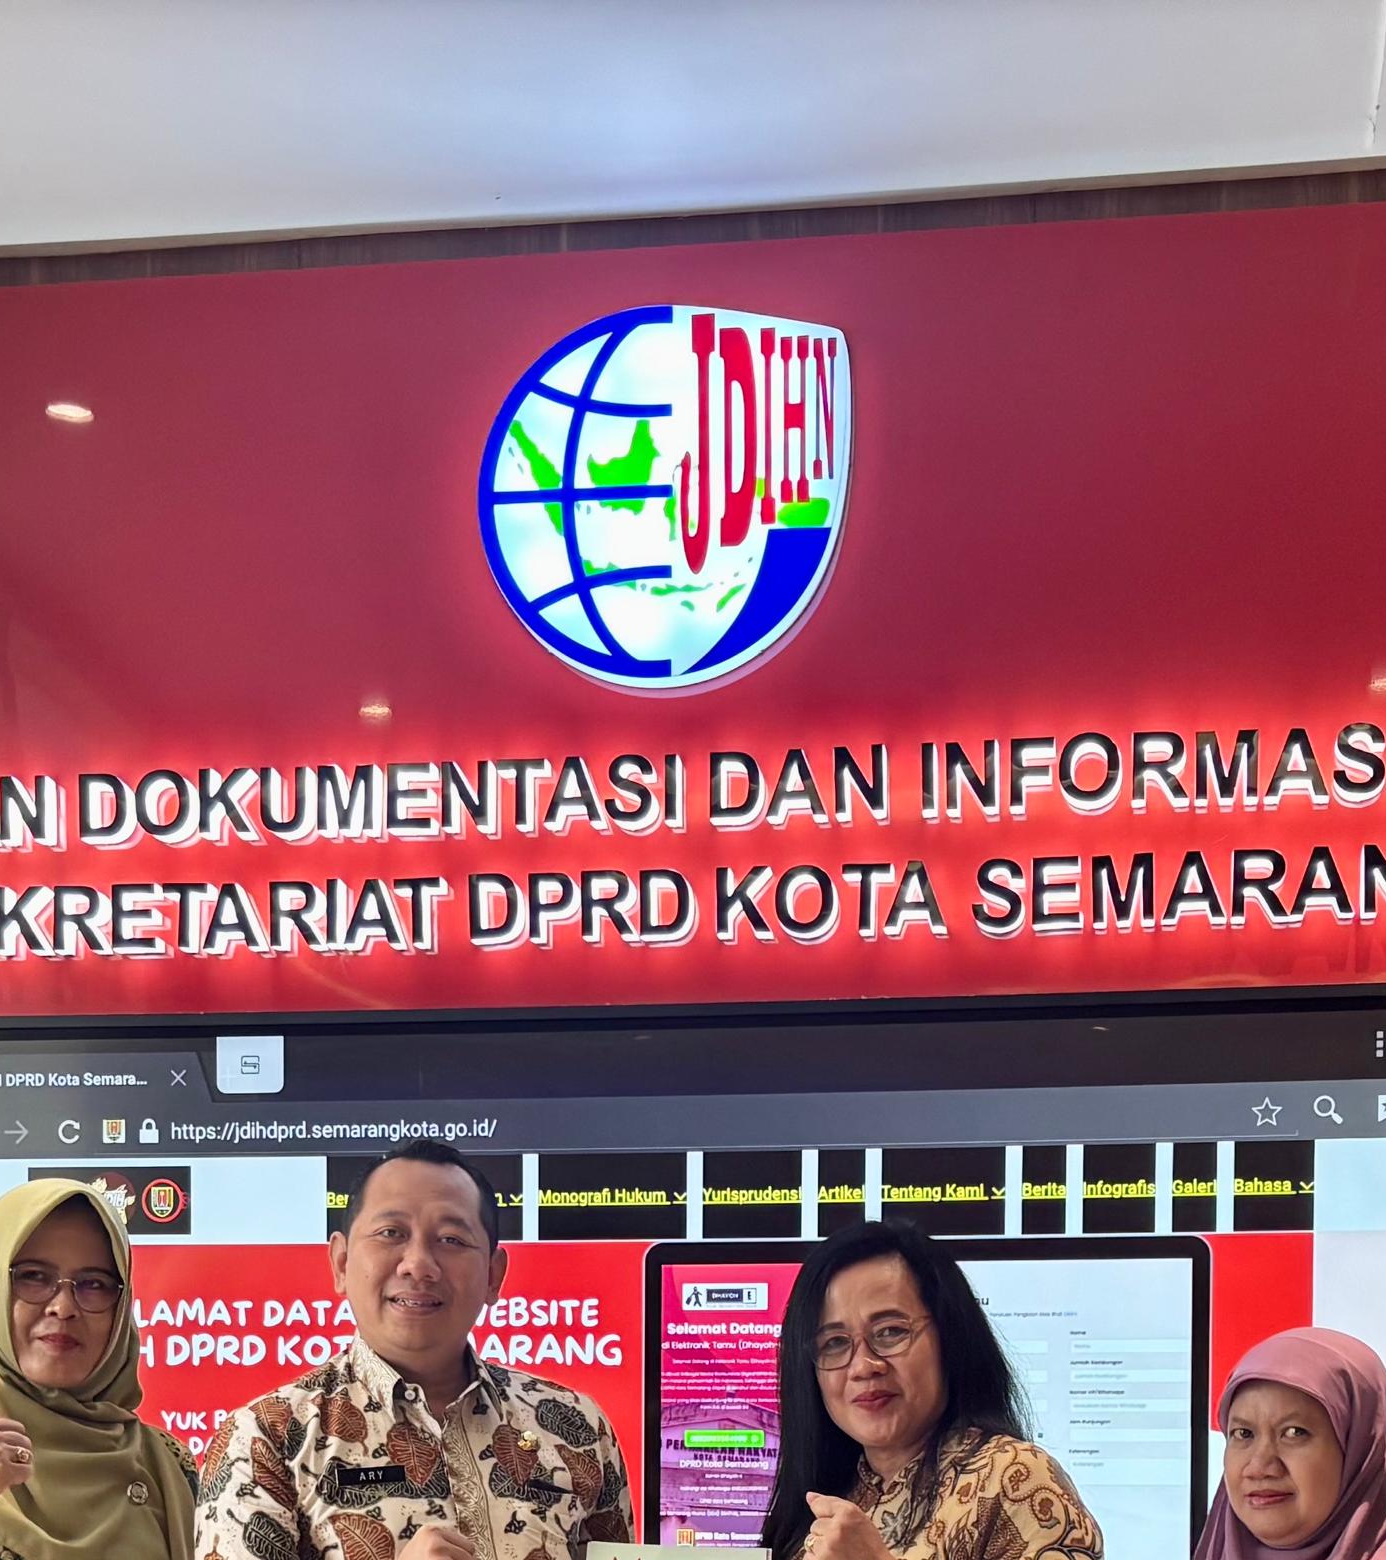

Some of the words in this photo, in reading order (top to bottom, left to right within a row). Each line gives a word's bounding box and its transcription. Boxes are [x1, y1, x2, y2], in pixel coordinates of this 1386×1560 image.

[680, 313, 837, 575] JDIHN
[78, 753, 685, 844] DOKUMENTASI
[708, 742, 891, 828] DAN
[466, 867, 695, 945] DPRD
[714, 860, 947, 944] KOTA
[6, 1073, 45, 1087] DPRD
[48, 1072, 80, 1087] Kota
[83, 1071, 148, 1086] Semara...
[170, 1118, 498, 1144] https://jdihdprd.semarangkota.go.id/
[538, 1188, 611, 1208] Monografi
[614, 1188, 667, 1204] Hukum
[817, 1184, 866, 1201] Artikel
[881, 1183, 942, 1202] Tentang
[944, 1183, 986, 1199] Kami
[1021, 1181, 1067, 1198] Berita
[1083, 1179, 1156, 1199] Infografis
[1233, 1177, 1293, 1194] Bahasa
[666, 1322, 728, 1335] Selamat
[729, 1323, 782, 1338] Datang
[165, 1333, 266, 1367] DPRD
[671, 1340, 710, 1350] Elektronik
[712, 1341, 737, 1350] Tamu
[160, 1409, 208, 1431] YUK
[358, 1470, 385, 1481] ARY
